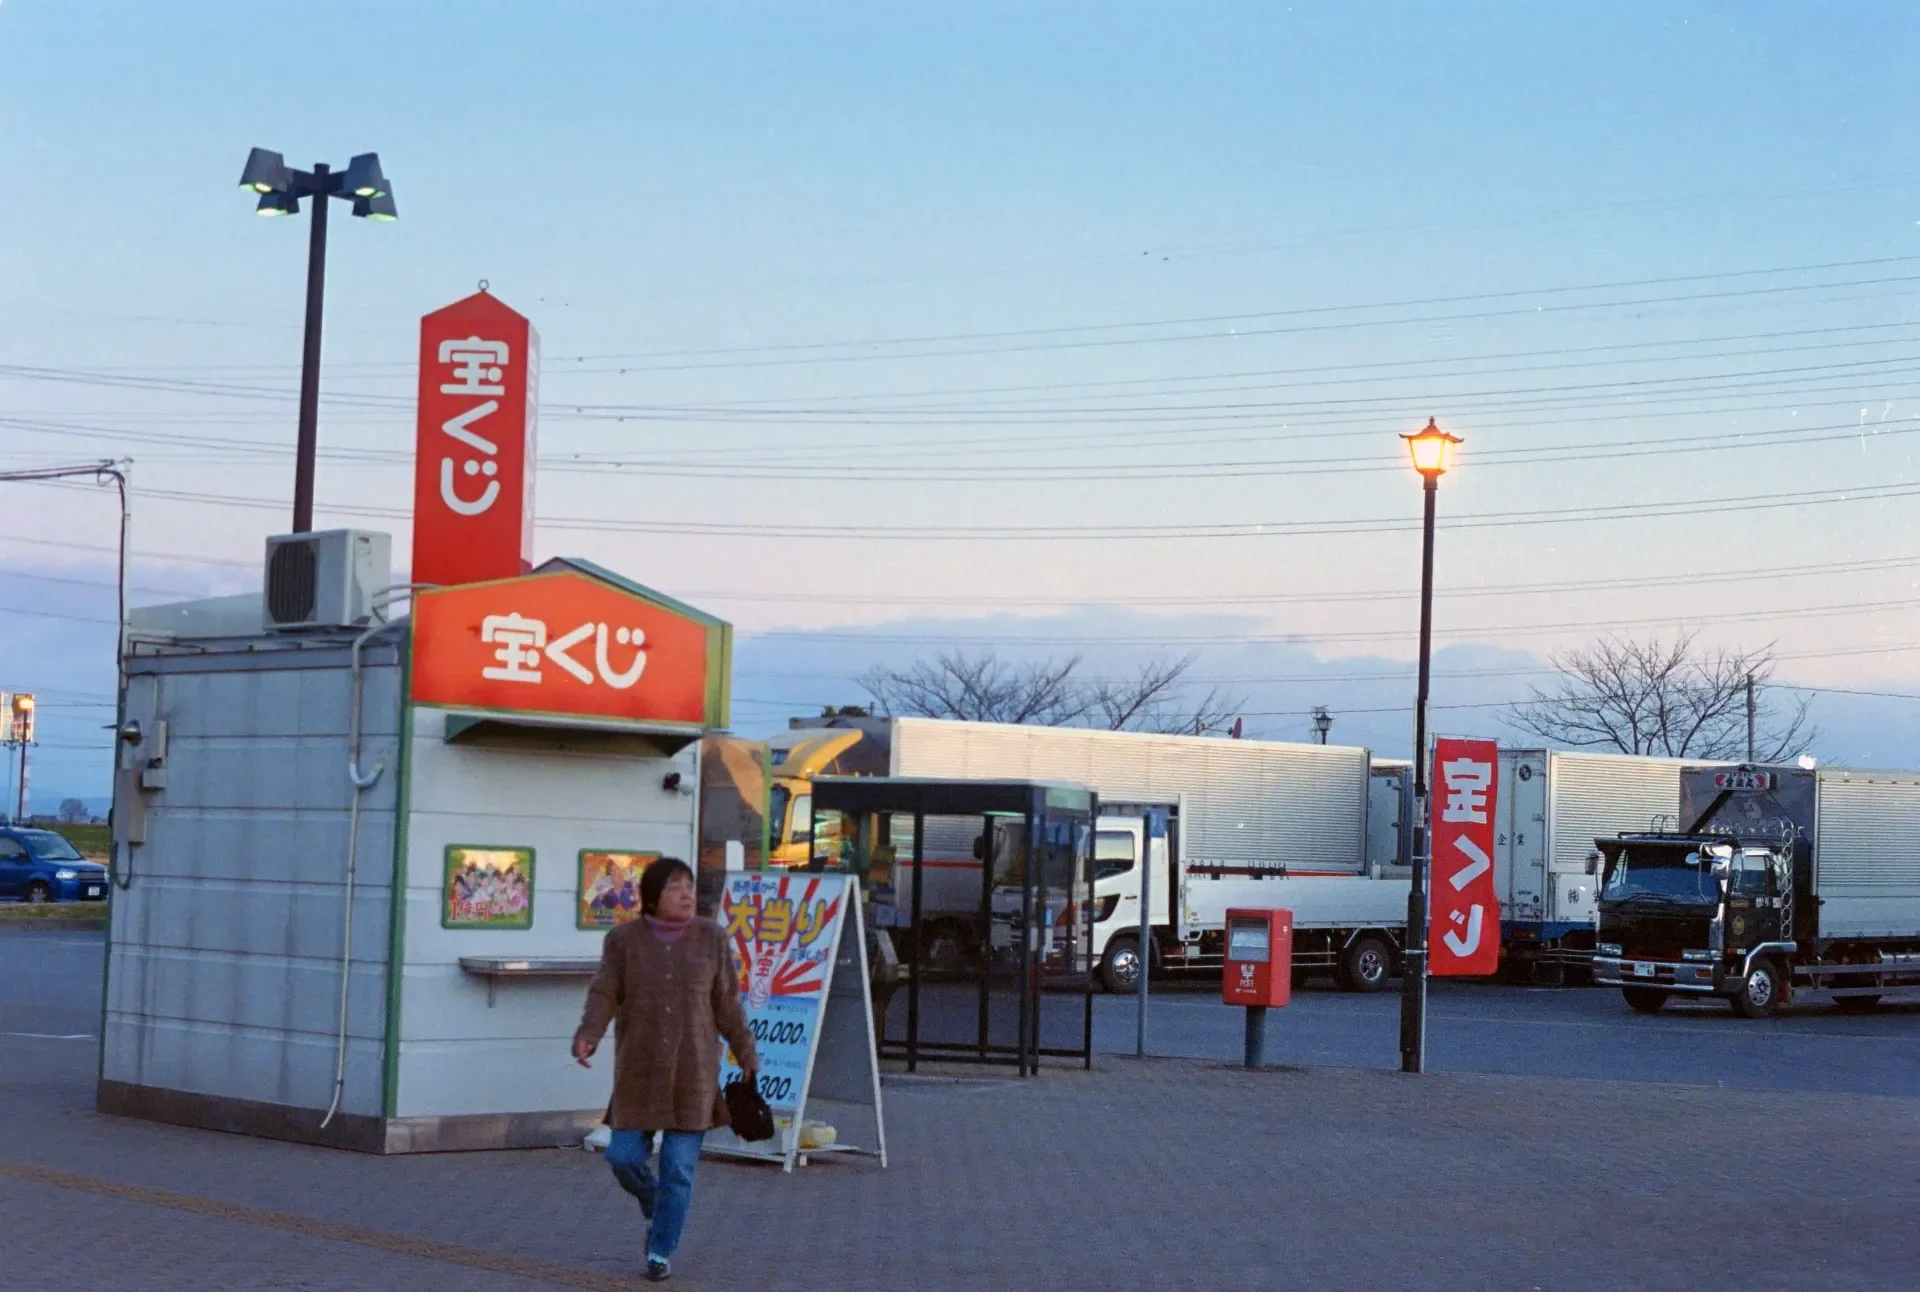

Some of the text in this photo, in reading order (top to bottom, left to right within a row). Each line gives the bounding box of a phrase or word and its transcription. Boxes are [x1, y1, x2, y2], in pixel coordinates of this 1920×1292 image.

[438, 335, 509, 516] 宝くじ
[481, 611, 648, 689] 宝くじ
[727, 895, 826, 945] 大当り
